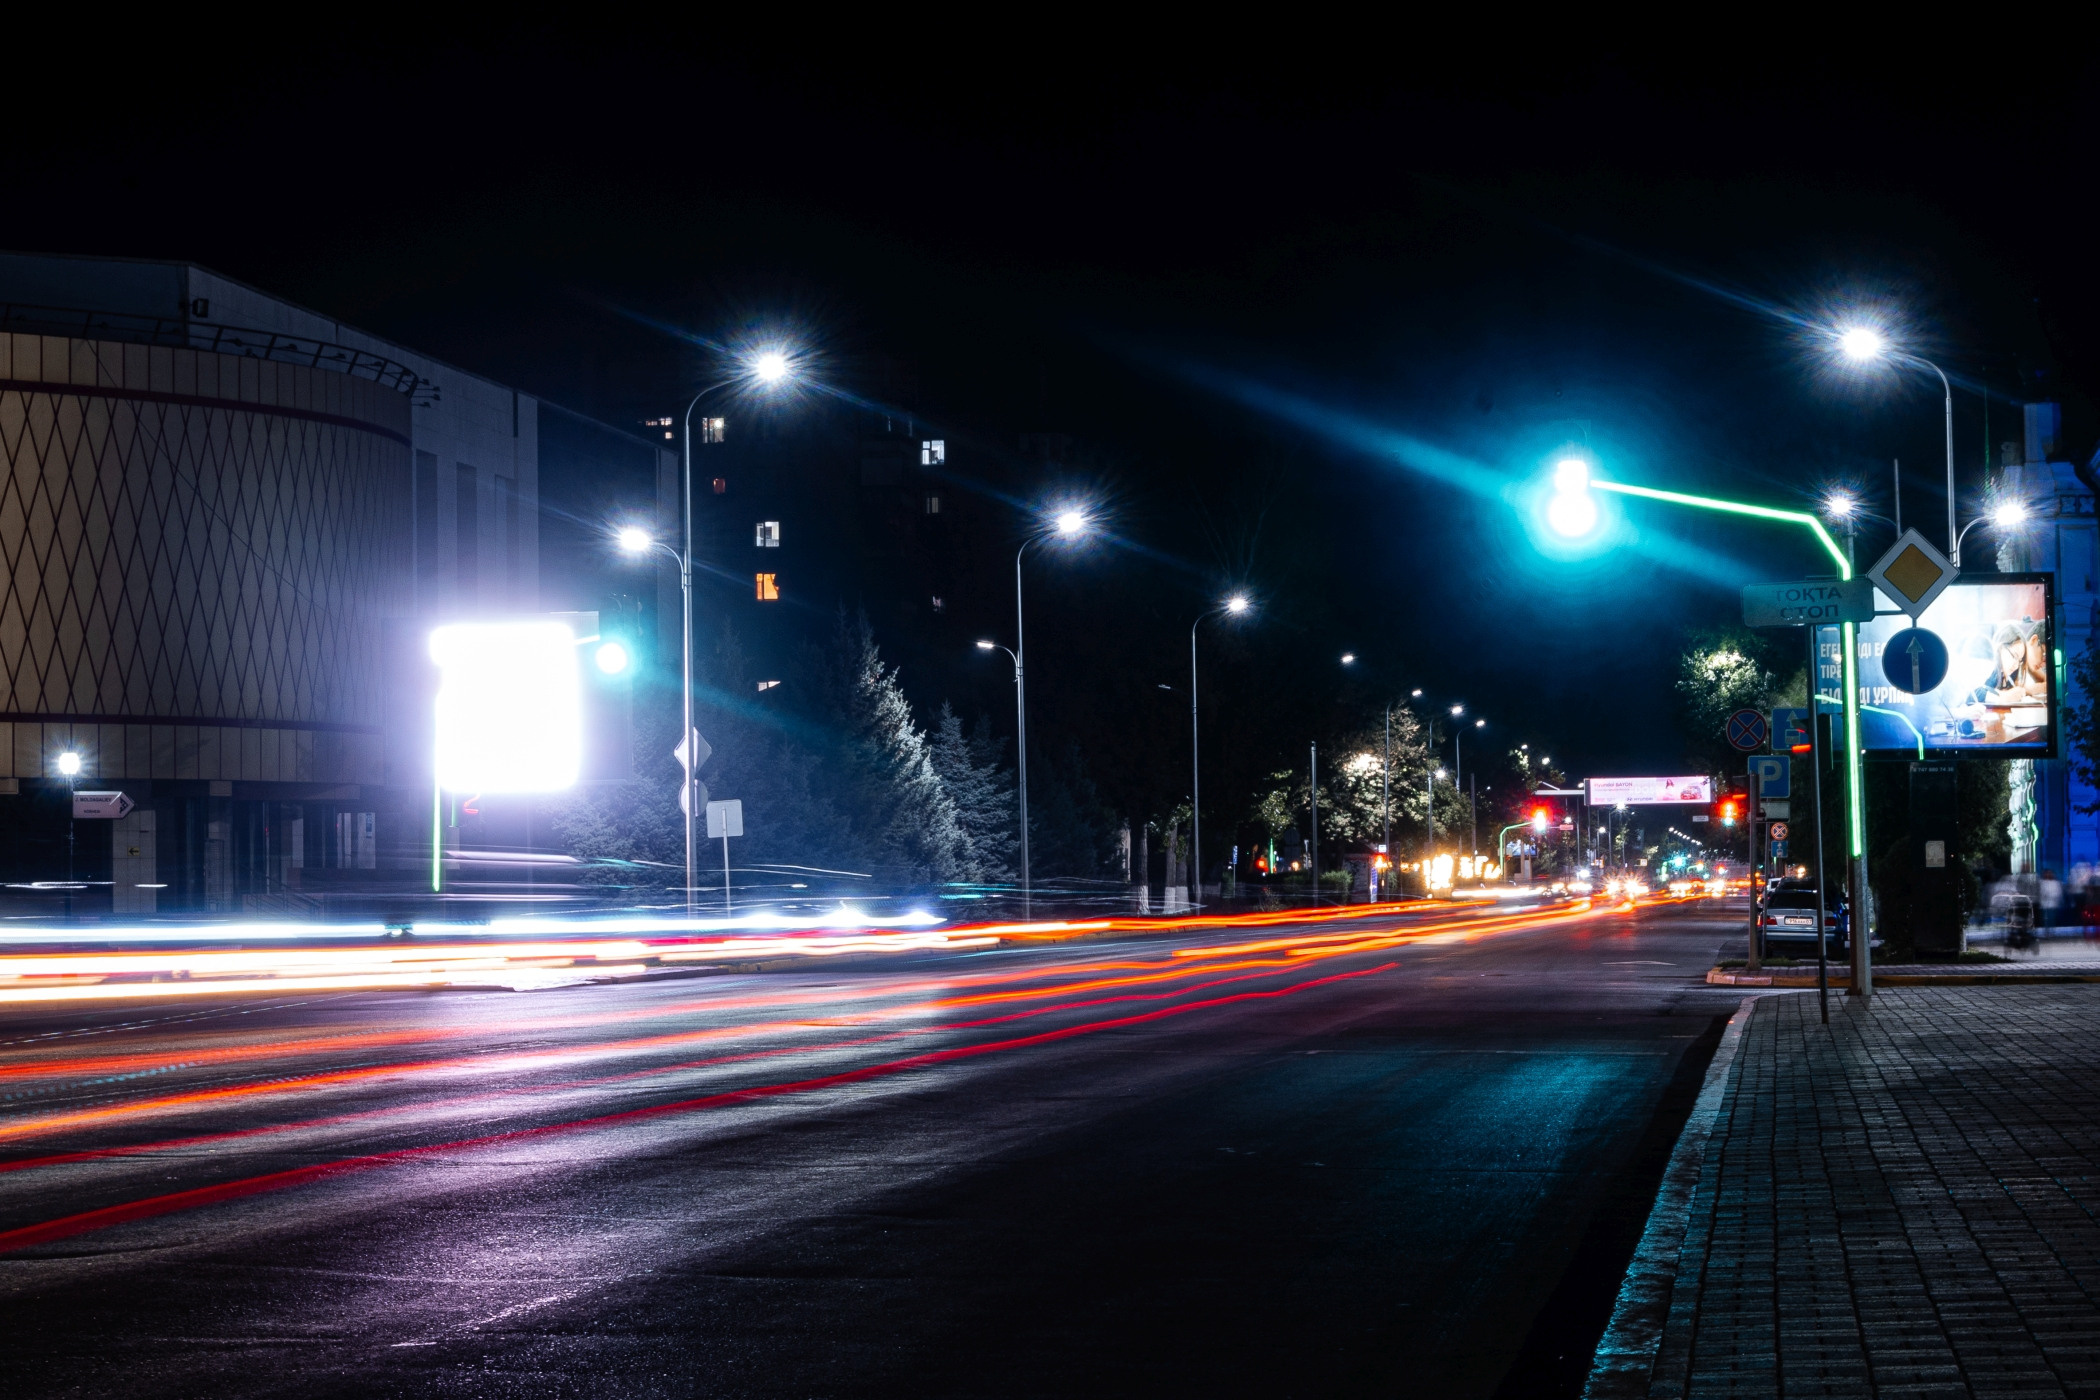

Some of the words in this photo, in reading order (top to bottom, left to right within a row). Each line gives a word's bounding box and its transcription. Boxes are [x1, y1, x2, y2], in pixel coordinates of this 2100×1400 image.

[1774, 586, 1843, 603] ТОҚТА
[1779, 604, 1839, 620] СТОП
[1820, 664, 1842, 679] ТІРЕ
[1820, 686, 1871, 706] БІЛДІ
